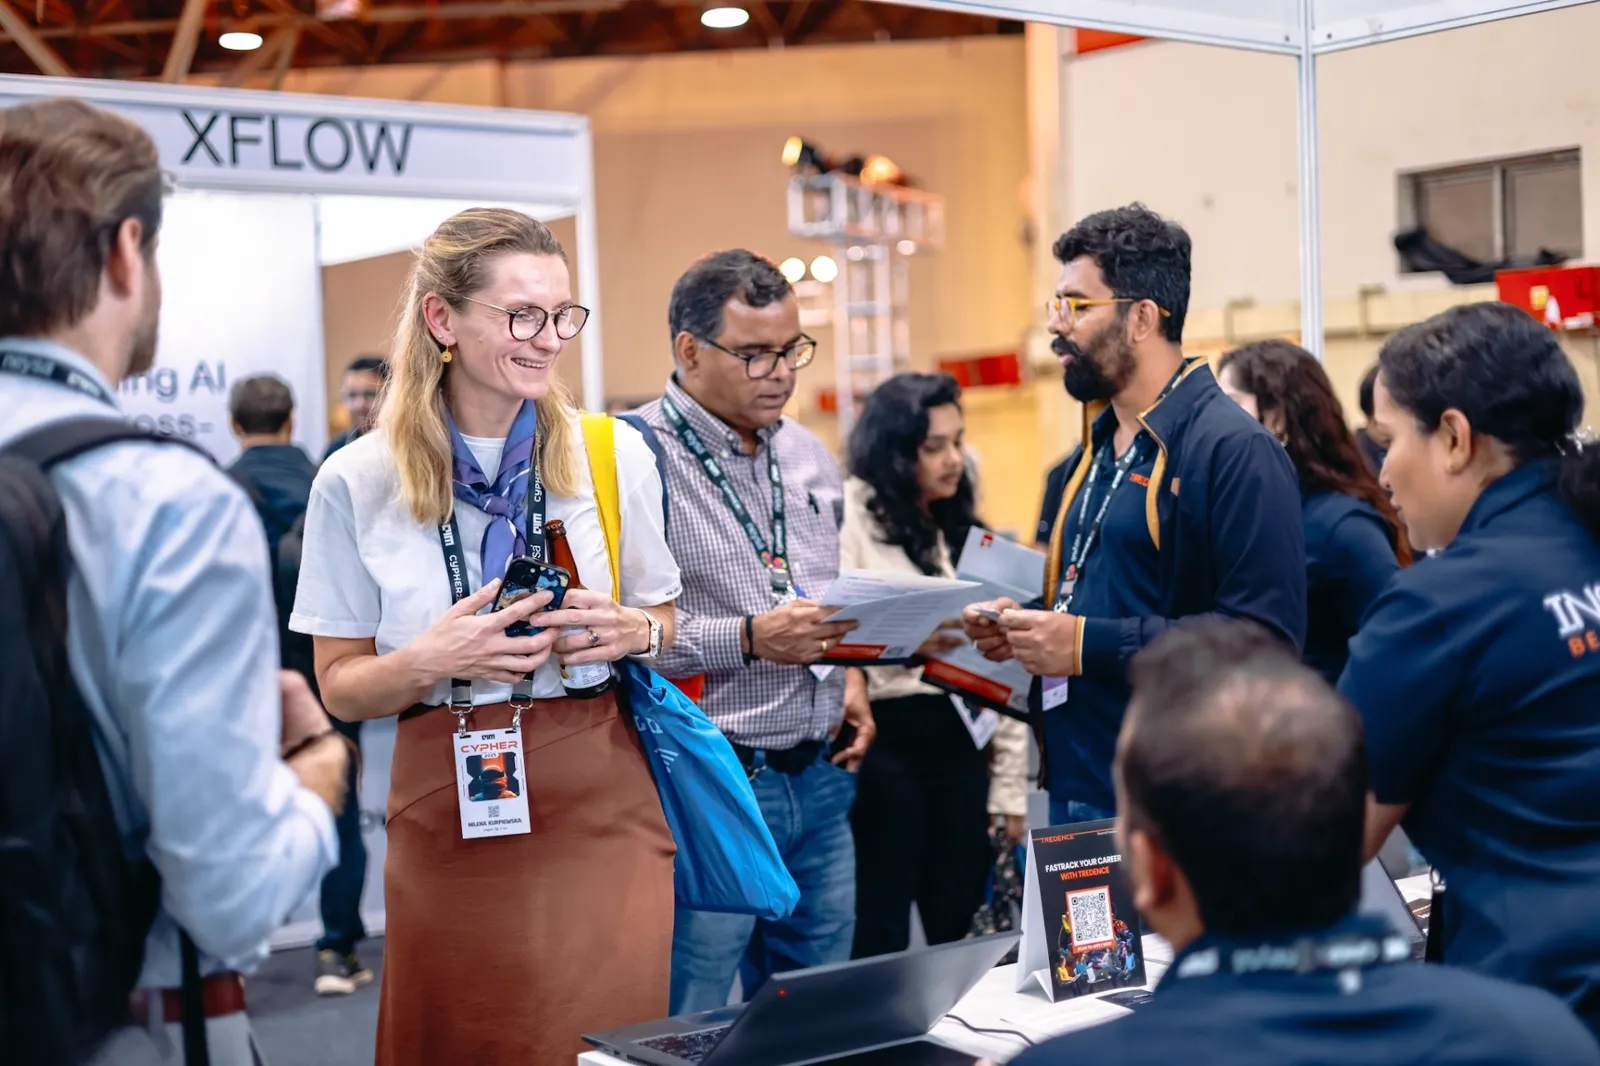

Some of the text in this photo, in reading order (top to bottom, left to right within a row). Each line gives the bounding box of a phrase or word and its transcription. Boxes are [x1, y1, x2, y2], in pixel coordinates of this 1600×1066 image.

[180, 110, 413, 174] XFLOW
[188, 360, 226, 395] AI
[460, 741, 519, 753] CYPHER
[1041, 833, 1075, 844] TREDENCE
[1045, 854, 1122, 873] FASTRACK YOUR CAREER
[1060, 865, 1110, 881] WITH TREDENCE
